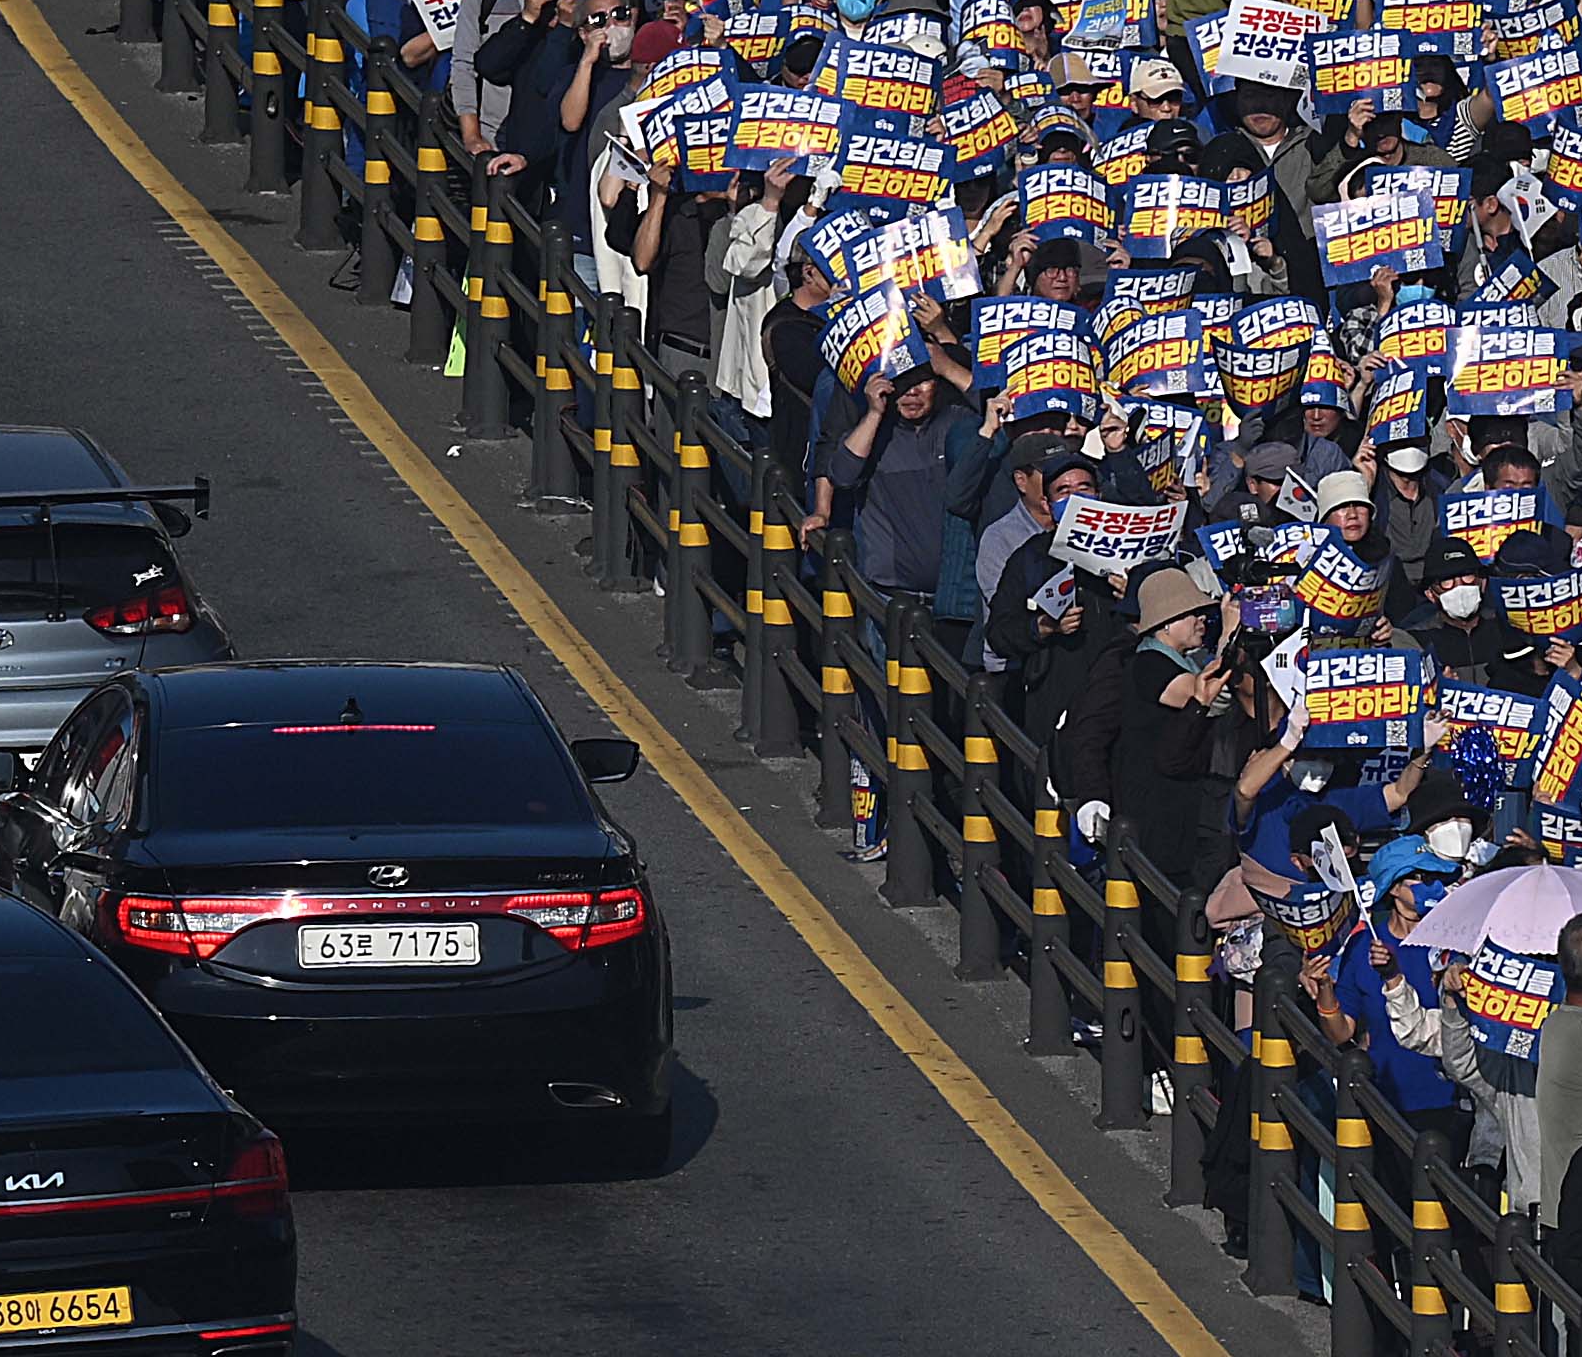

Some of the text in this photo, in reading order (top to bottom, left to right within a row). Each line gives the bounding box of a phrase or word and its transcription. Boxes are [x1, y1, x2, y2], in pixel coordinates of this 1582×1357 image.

[846, 133, 944, 173] 김건희를
[842, 164, 949, 202] 특검하라!
[1305, 653, 1407, 691] 김건희를
[1306, 686, 1420, 721] 특검하라!
[319, 931, 461, 959] 63로 7175
[5, 1171, 65, 1192] KIA
[50, 1292, 120, 1326] 6654
